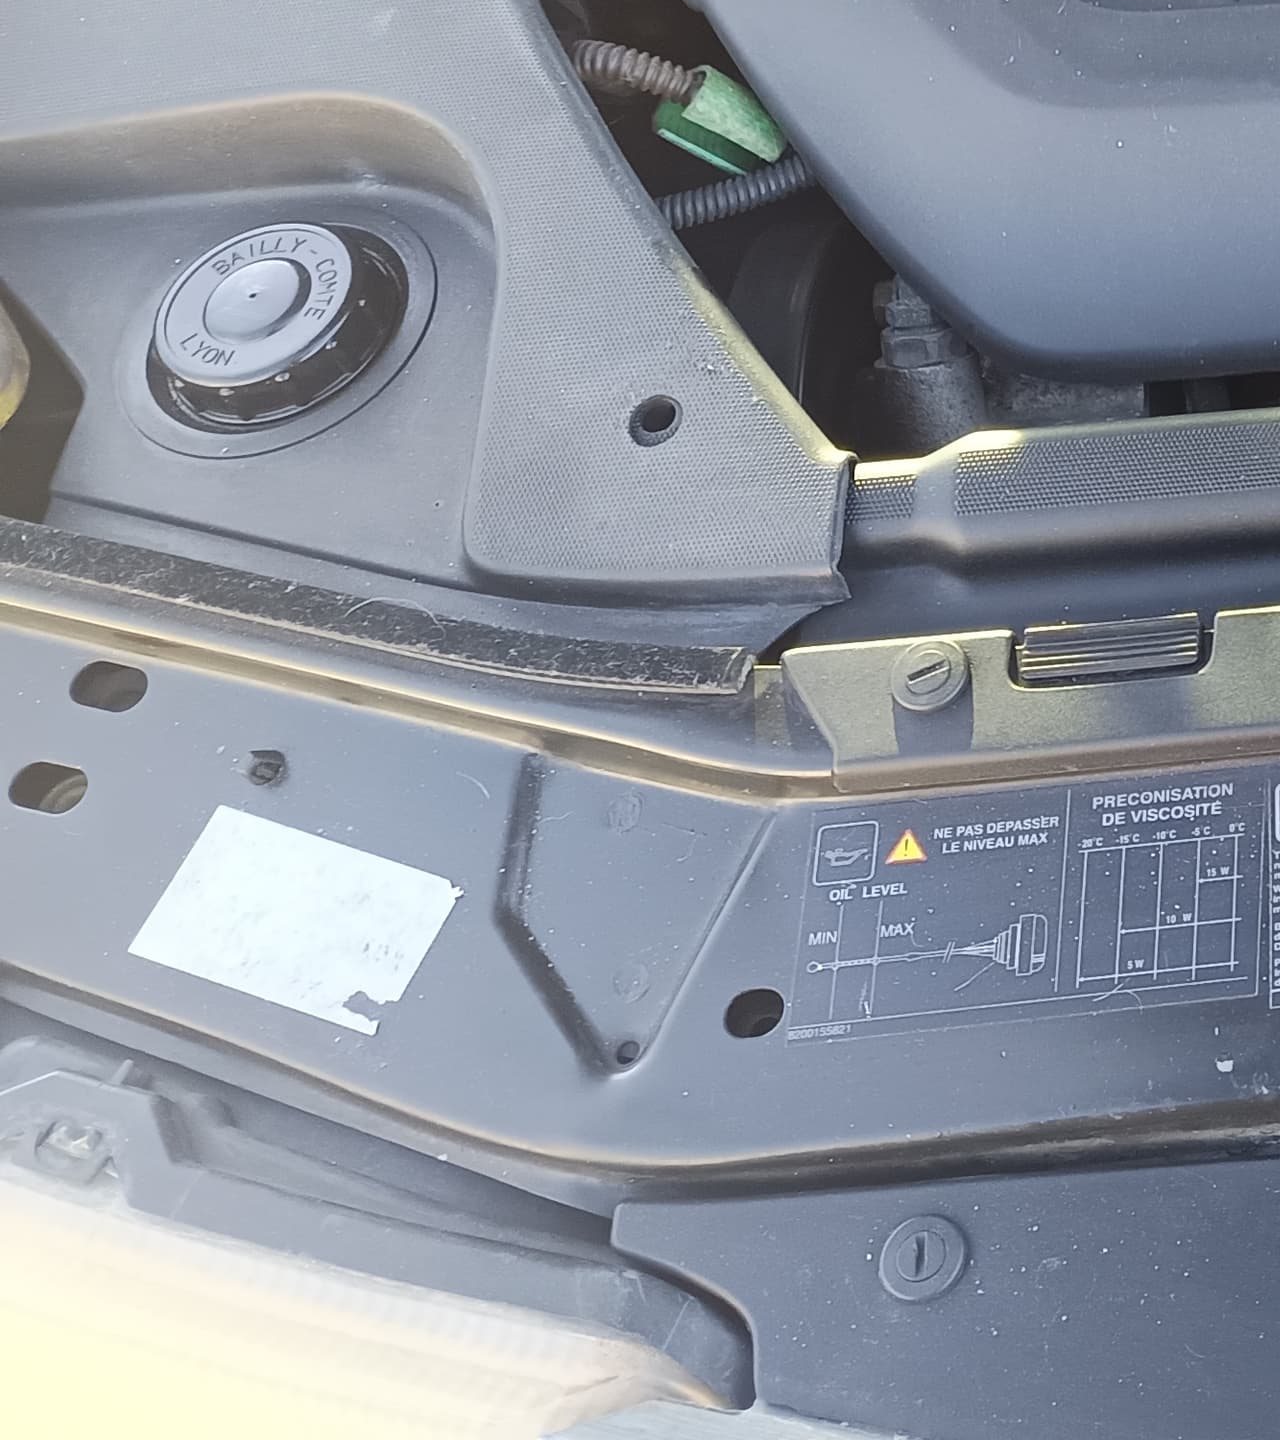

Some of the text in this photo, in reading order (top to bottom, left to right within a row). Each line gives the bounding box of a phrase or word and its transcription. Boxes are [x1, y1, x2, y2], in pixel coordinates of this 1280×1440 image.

[180, 332, 237, 366] LYON
[1092, 783, 1234, 810] PRECONISATION
[1102, 811, 1128, 826] DE
[934, 816, 1059, 839] NE PAS DEPASSER
[942, 832, 1048, 854] LE NIVEAU MAX
[1206, 866, 1230, 877] 15 W
[829, 882, 908, 901] OIL LEVEL
[1166, 912, 1192, 924] 10 W
[880, 922, 915, 937] MAX
[809, 931, 838, 946] MIN
[1127, 959, 1144, 969] 5 W
